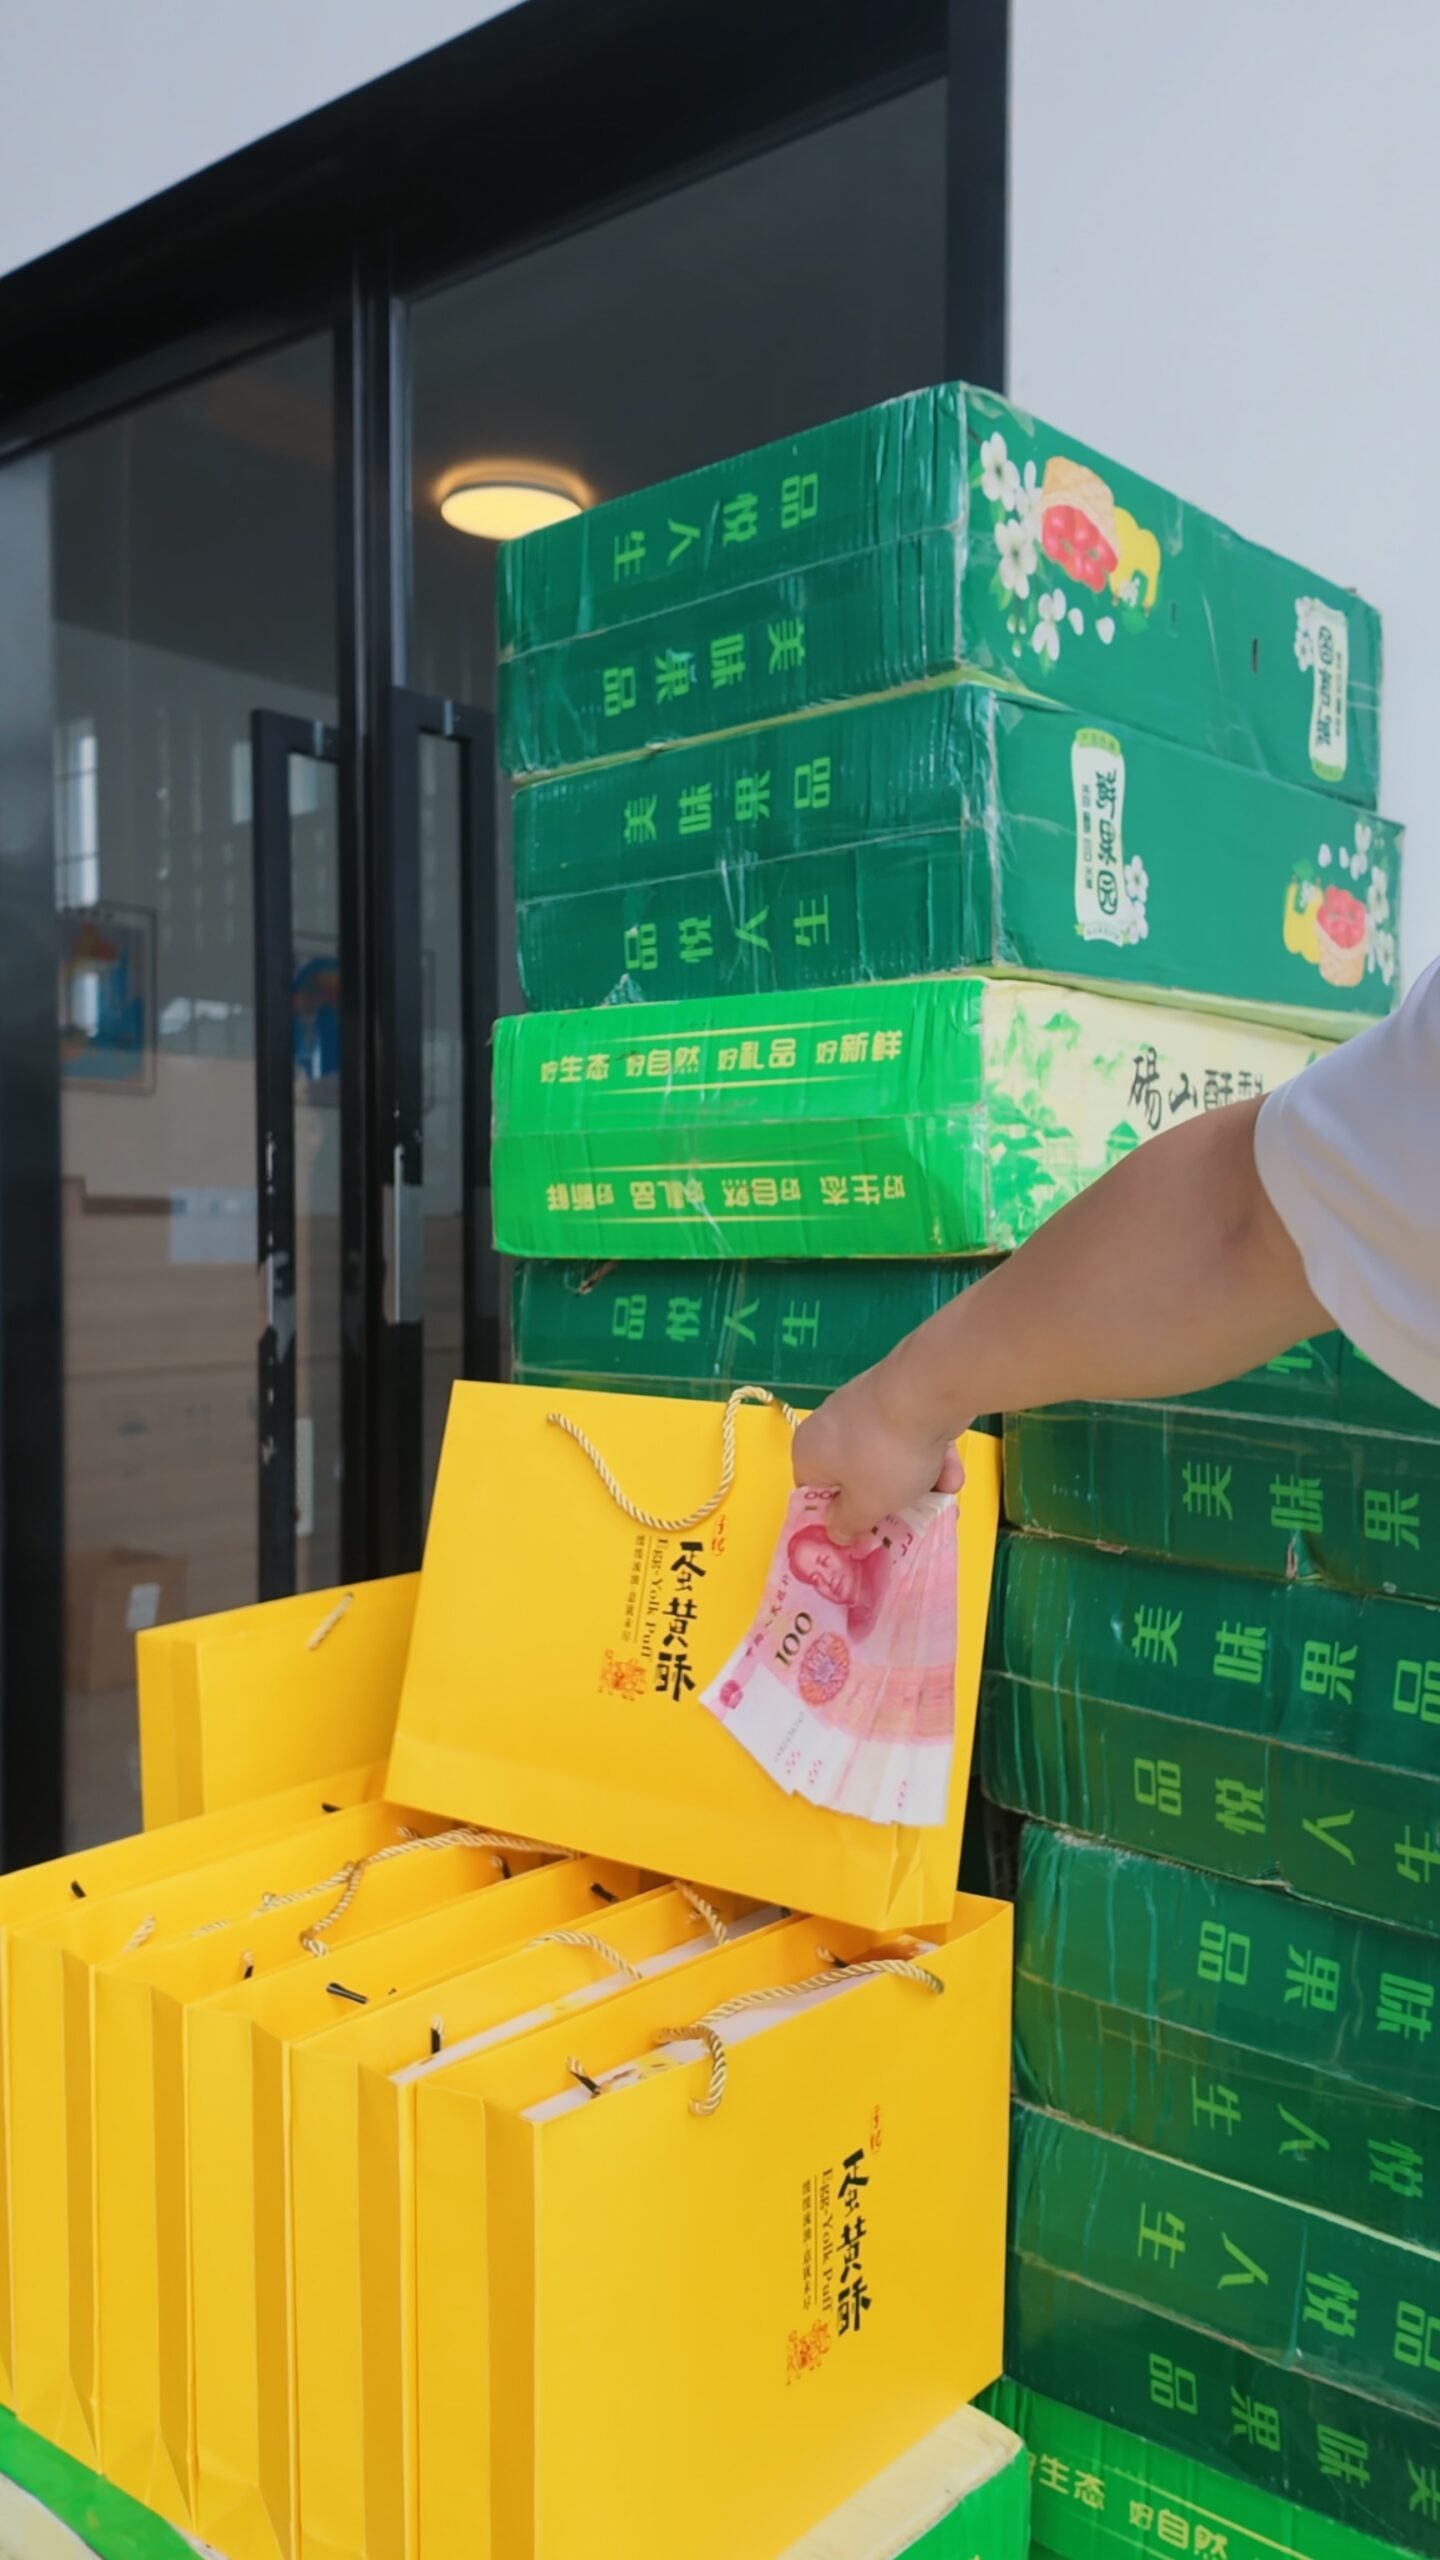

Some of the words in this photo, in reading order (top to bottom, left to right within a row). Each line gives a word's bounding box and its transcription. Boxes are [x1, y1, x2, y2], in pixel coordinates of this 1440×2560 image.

[613, 472, 819, 582] 品悦人生
[602, 616, 806, 717] 美味果品
[624, 756, 831, 845] 美味果品
[624, 894, 830, 971] 品悦人生
[540, 1053, 610, 1083] 好生态
[626, 1045, 699, 1076] 好自然
[717, 1038, 796, 1071] 好礼品
[816, 1030, 903, 1065] 好新鲜
[546, 1183, 614, 1211] 好新鲜
[722, 1177, 801, 1207] 好自然
[820, 1174, 906, 1206] 好生态
[612, 1294, 820, 1348] 品悦人生
[653, 1541, 707, 1702] 蛋黄酥
[775, 1610, 814, 1666] 100
